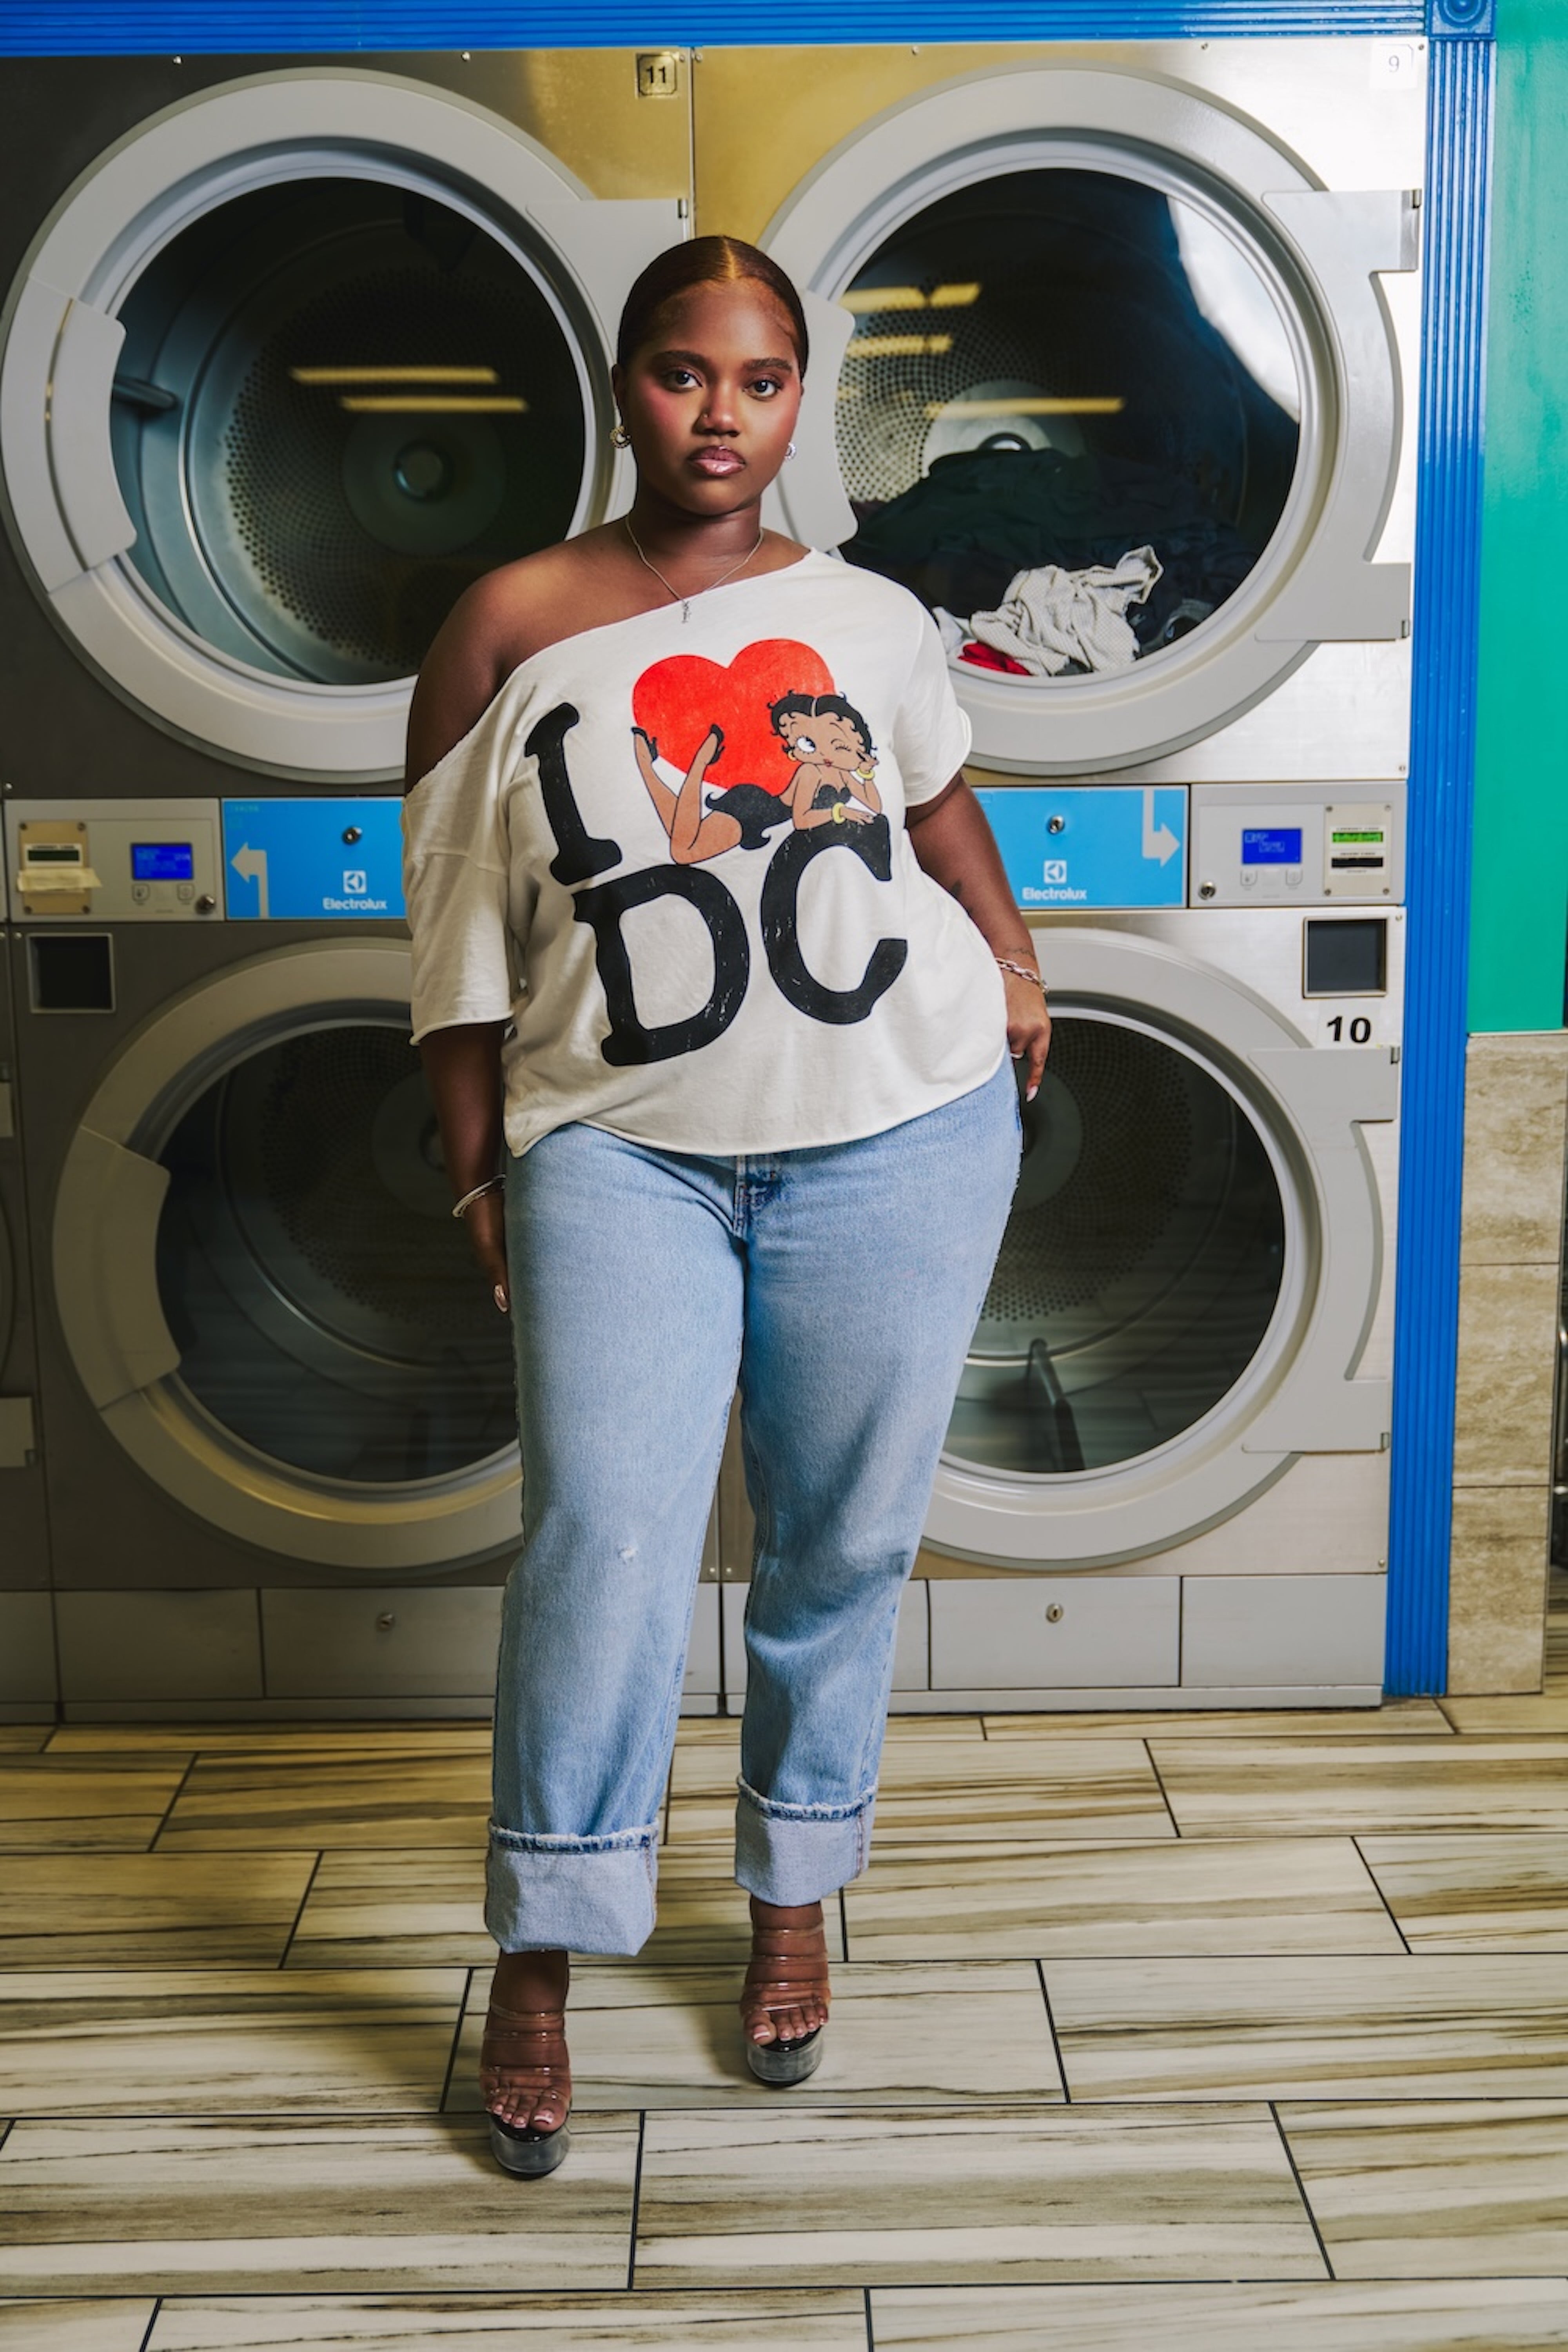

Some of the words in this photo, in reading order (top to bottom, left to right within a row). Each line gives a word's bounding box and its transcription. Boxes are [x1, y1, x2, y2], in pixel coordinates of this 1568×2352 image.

[1388, 54, 1399, 73] 9
[646, 65, 666, 83] 11
[524, 702, 622, 886] I
[1022, 887, 1088, 900] Electrolux
[322, 897, 388, 910] Electrolux
[572, 813, 908, 1067] DC
[1327, 1016, 1371, 1043] 10
